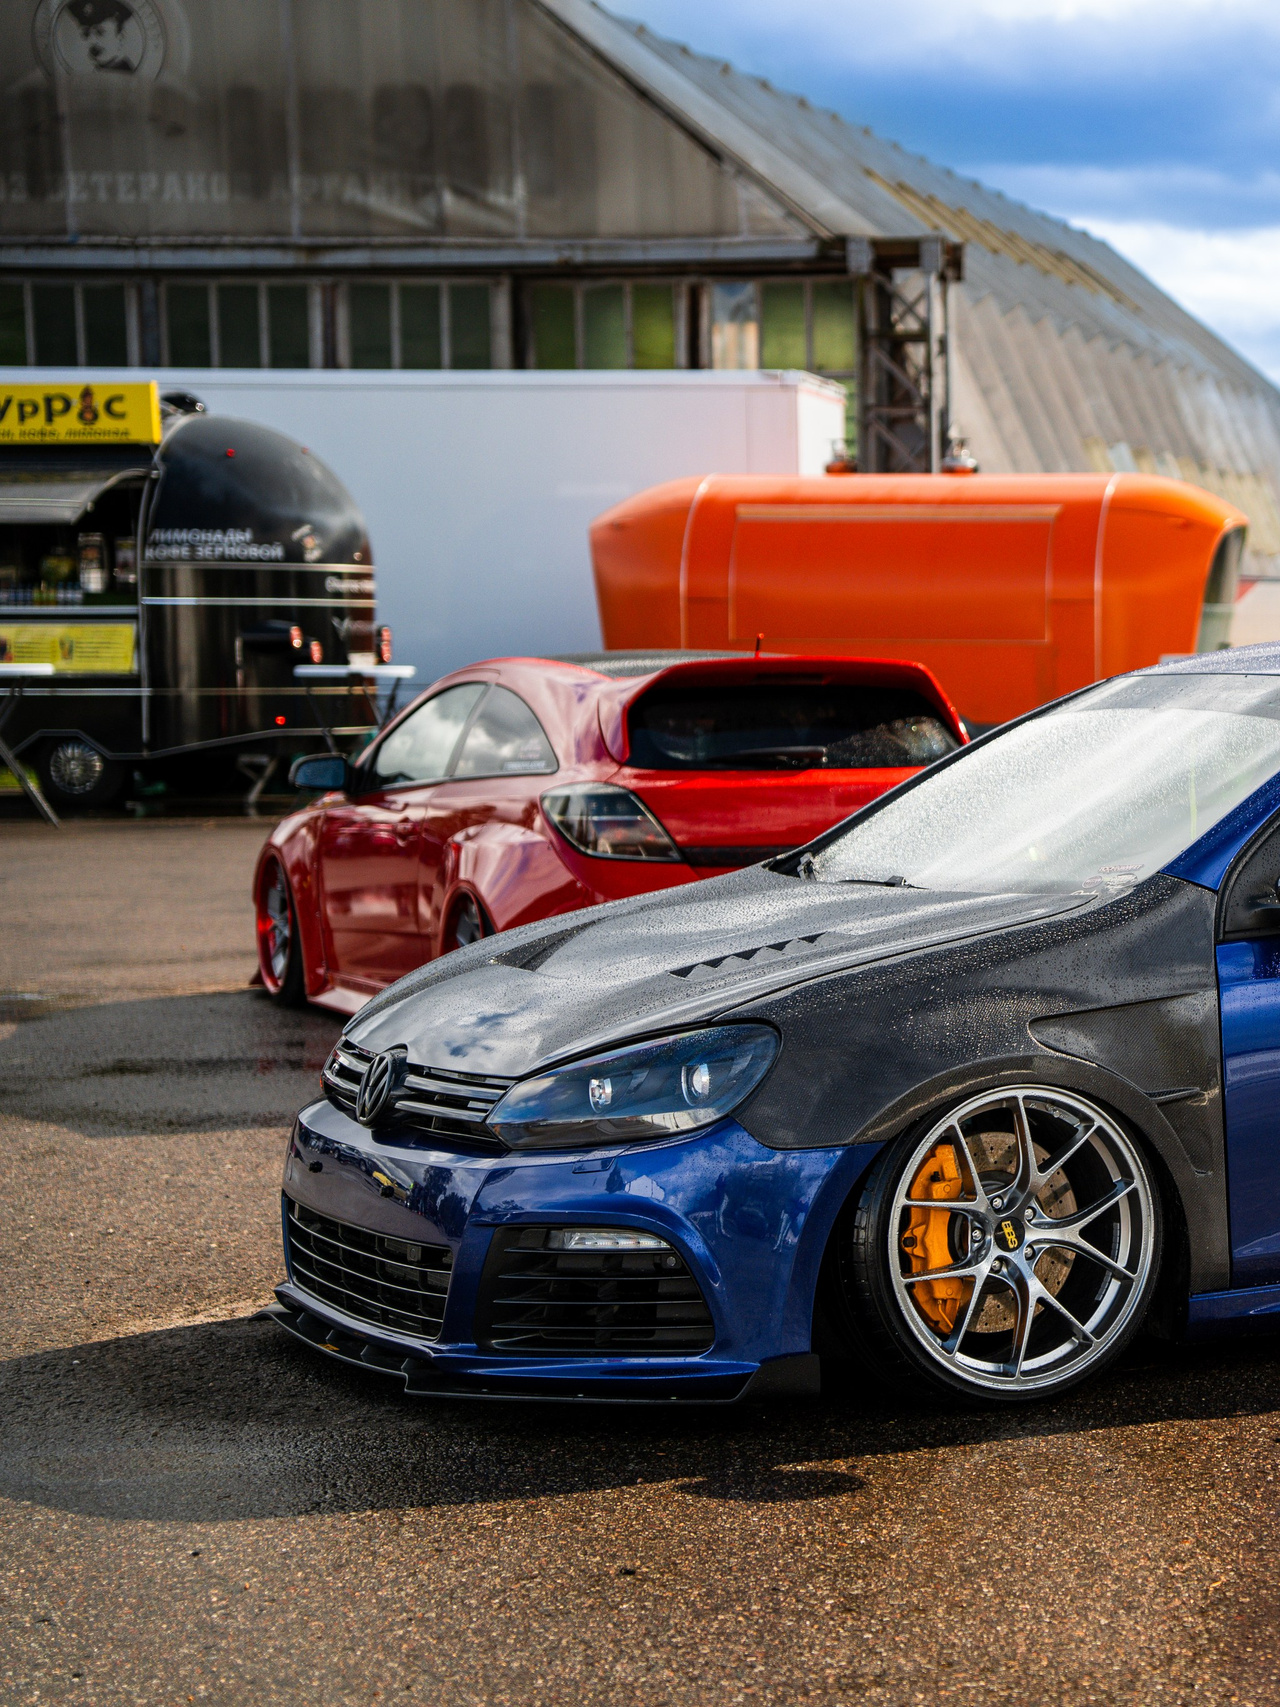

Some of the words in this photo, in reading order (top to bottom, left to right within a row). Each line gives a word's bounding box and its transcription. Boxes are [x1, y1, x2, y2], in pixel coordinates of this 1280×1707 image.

[150, 528, 253, 545] ЛИМОНАДЫ
[145, 544, 190, 560] КОФЕ
[194, 541, 284, 561] ЗЕРНОВОЙ
[1001, 1220, 1018, 1249] BBS
